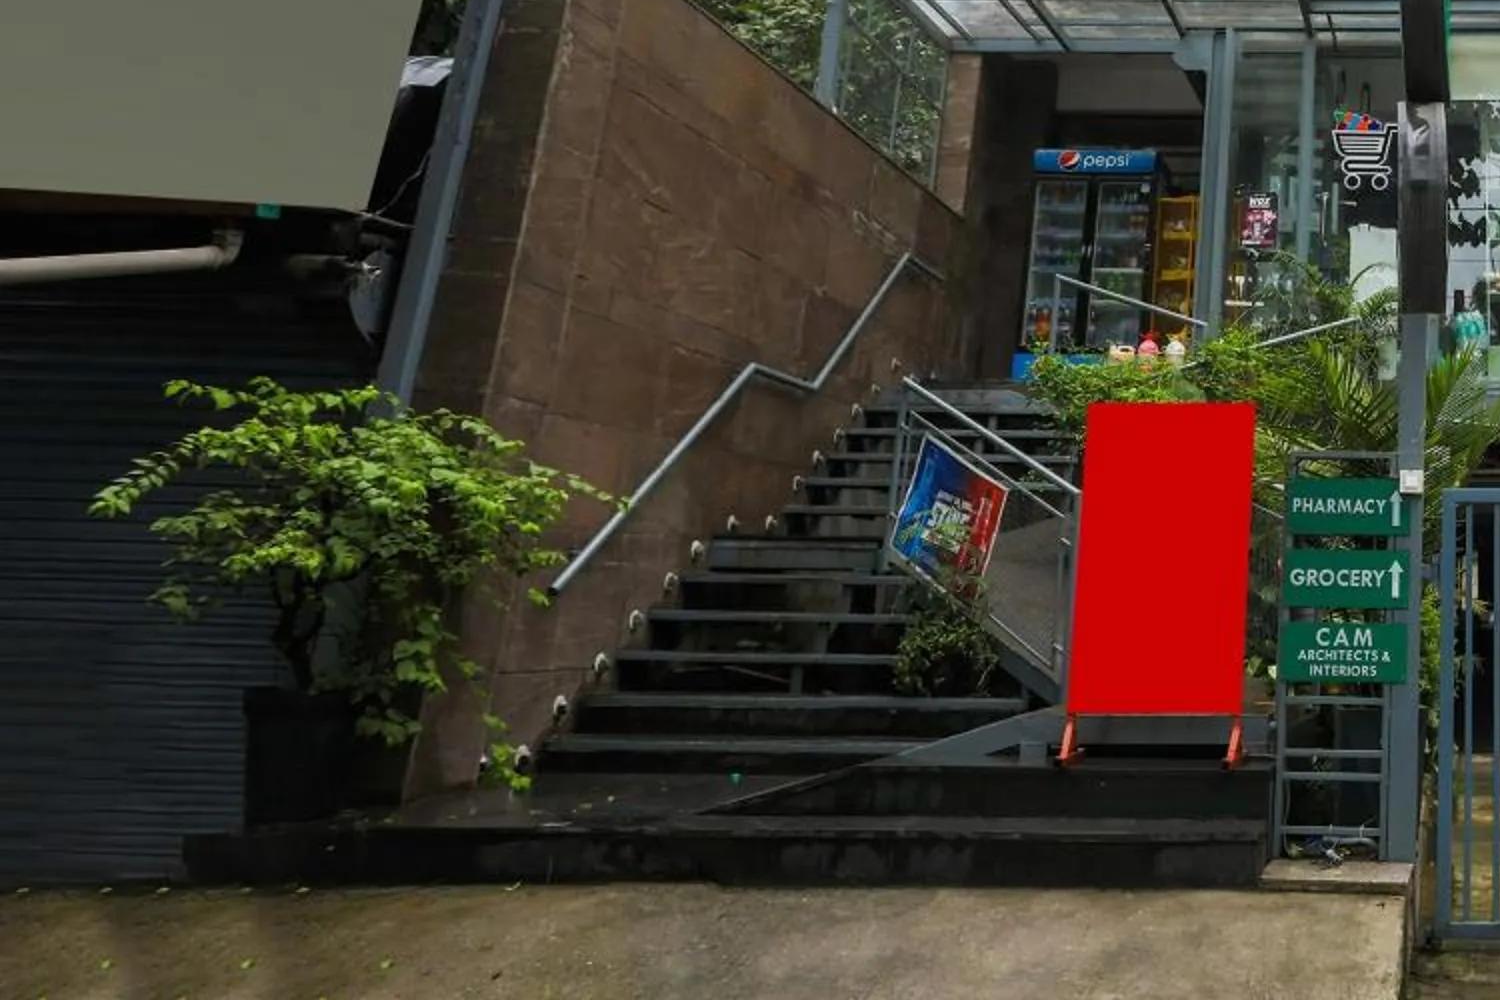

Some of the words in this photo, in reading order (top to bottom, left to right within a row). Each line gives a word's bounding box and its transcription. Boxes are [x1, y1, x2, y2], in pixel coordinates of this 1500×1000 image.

[1082, 153, 1130, 169] pepsi
[1292, 497, 1387, 515] PHARMACY
[1289, 567, 1386, 588] GROCERY
[1315, 627, 1374, 648] CAM
[1297, 648, 1379, 663] ARCHITECTS
[1382, 650, 1392, 663] &
[1308, 664, 1378, 678] INTERIORS
